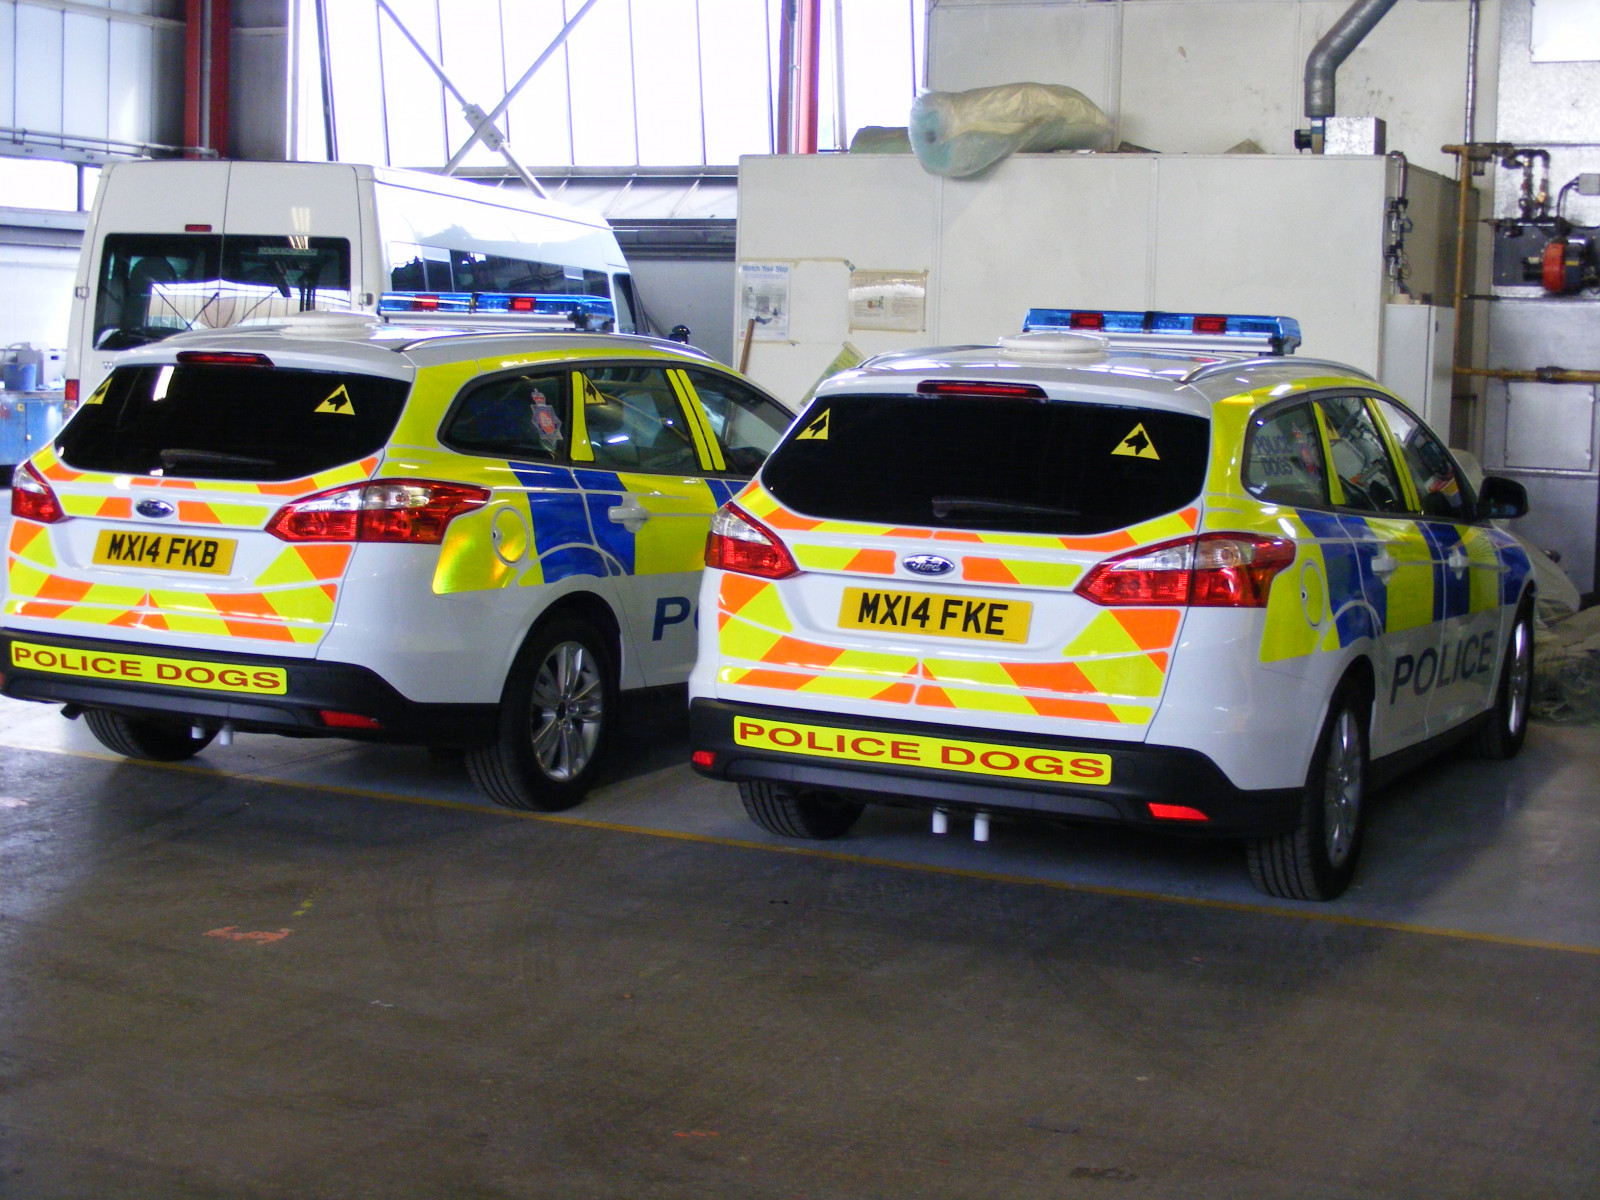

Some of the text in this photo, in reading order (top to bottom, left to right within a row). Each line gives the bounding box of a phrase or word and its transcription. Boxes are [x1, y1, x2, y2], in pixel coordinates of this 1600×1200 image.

[107, 533, 219, 568] MX14 FKB
[652, 596, 699, 641] P
[858, 592, 1009, 636] MX14 FKE
[14, 646, 281, 689] POLICE DOGS
[1390, 630, 1494, 704] POLICE
[739, 722, 1105, 779] POLICE DOGS
